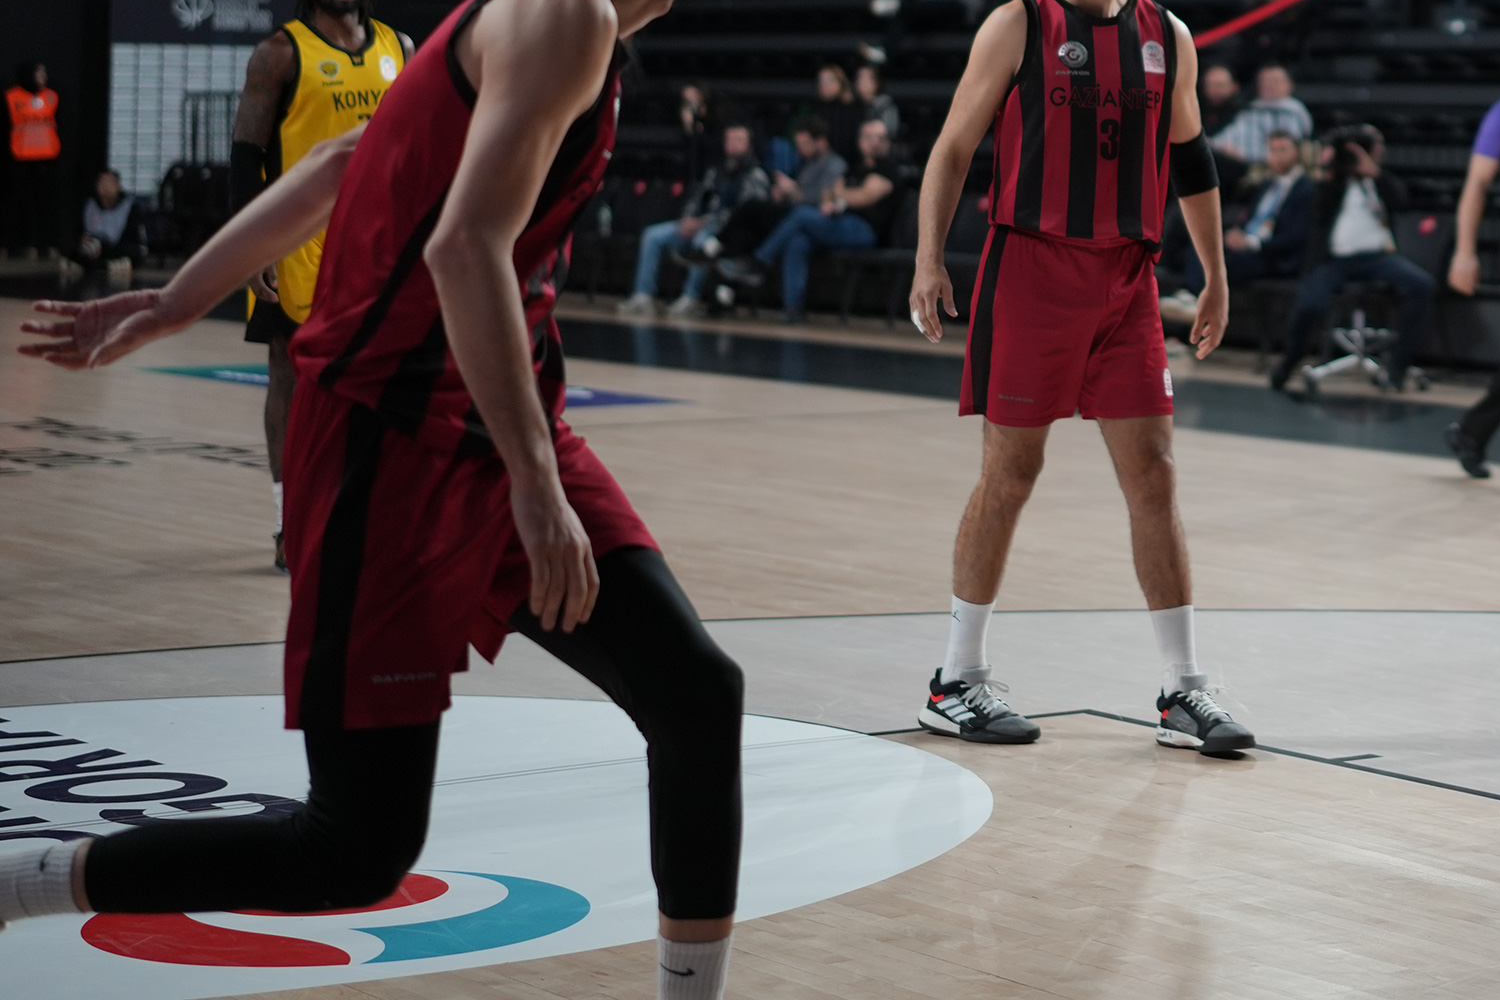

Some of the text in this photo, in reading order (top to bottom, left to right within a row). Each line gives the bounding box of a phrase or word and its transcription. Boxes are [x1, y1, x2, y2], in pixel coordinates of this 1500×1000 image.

[332, 88, 387, 112] KONY
[1050, 83, 1161, 112] GAZİANTEP
[1100, 118, 1120, 161] 3
